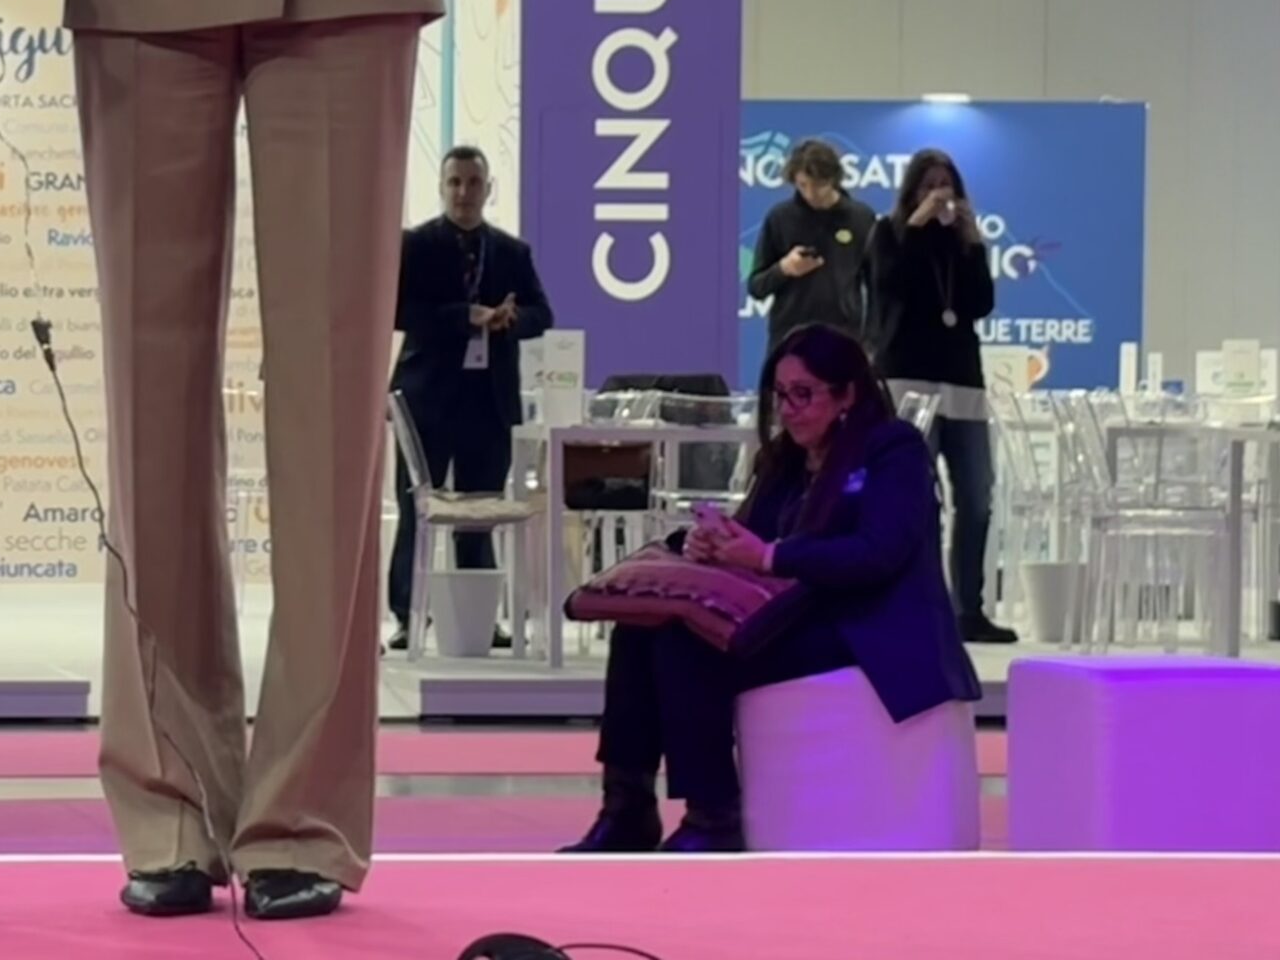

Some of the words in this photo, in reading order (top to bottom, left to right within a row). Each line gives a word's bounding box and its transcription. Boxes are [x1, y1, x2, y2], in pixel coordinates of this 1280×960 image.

[1014, 319, 1094, 343] TERRE
[13, 345, 36, 360] del
[23, 503, 105, 523] Amaro
[4, 526, 88, 551] secche
